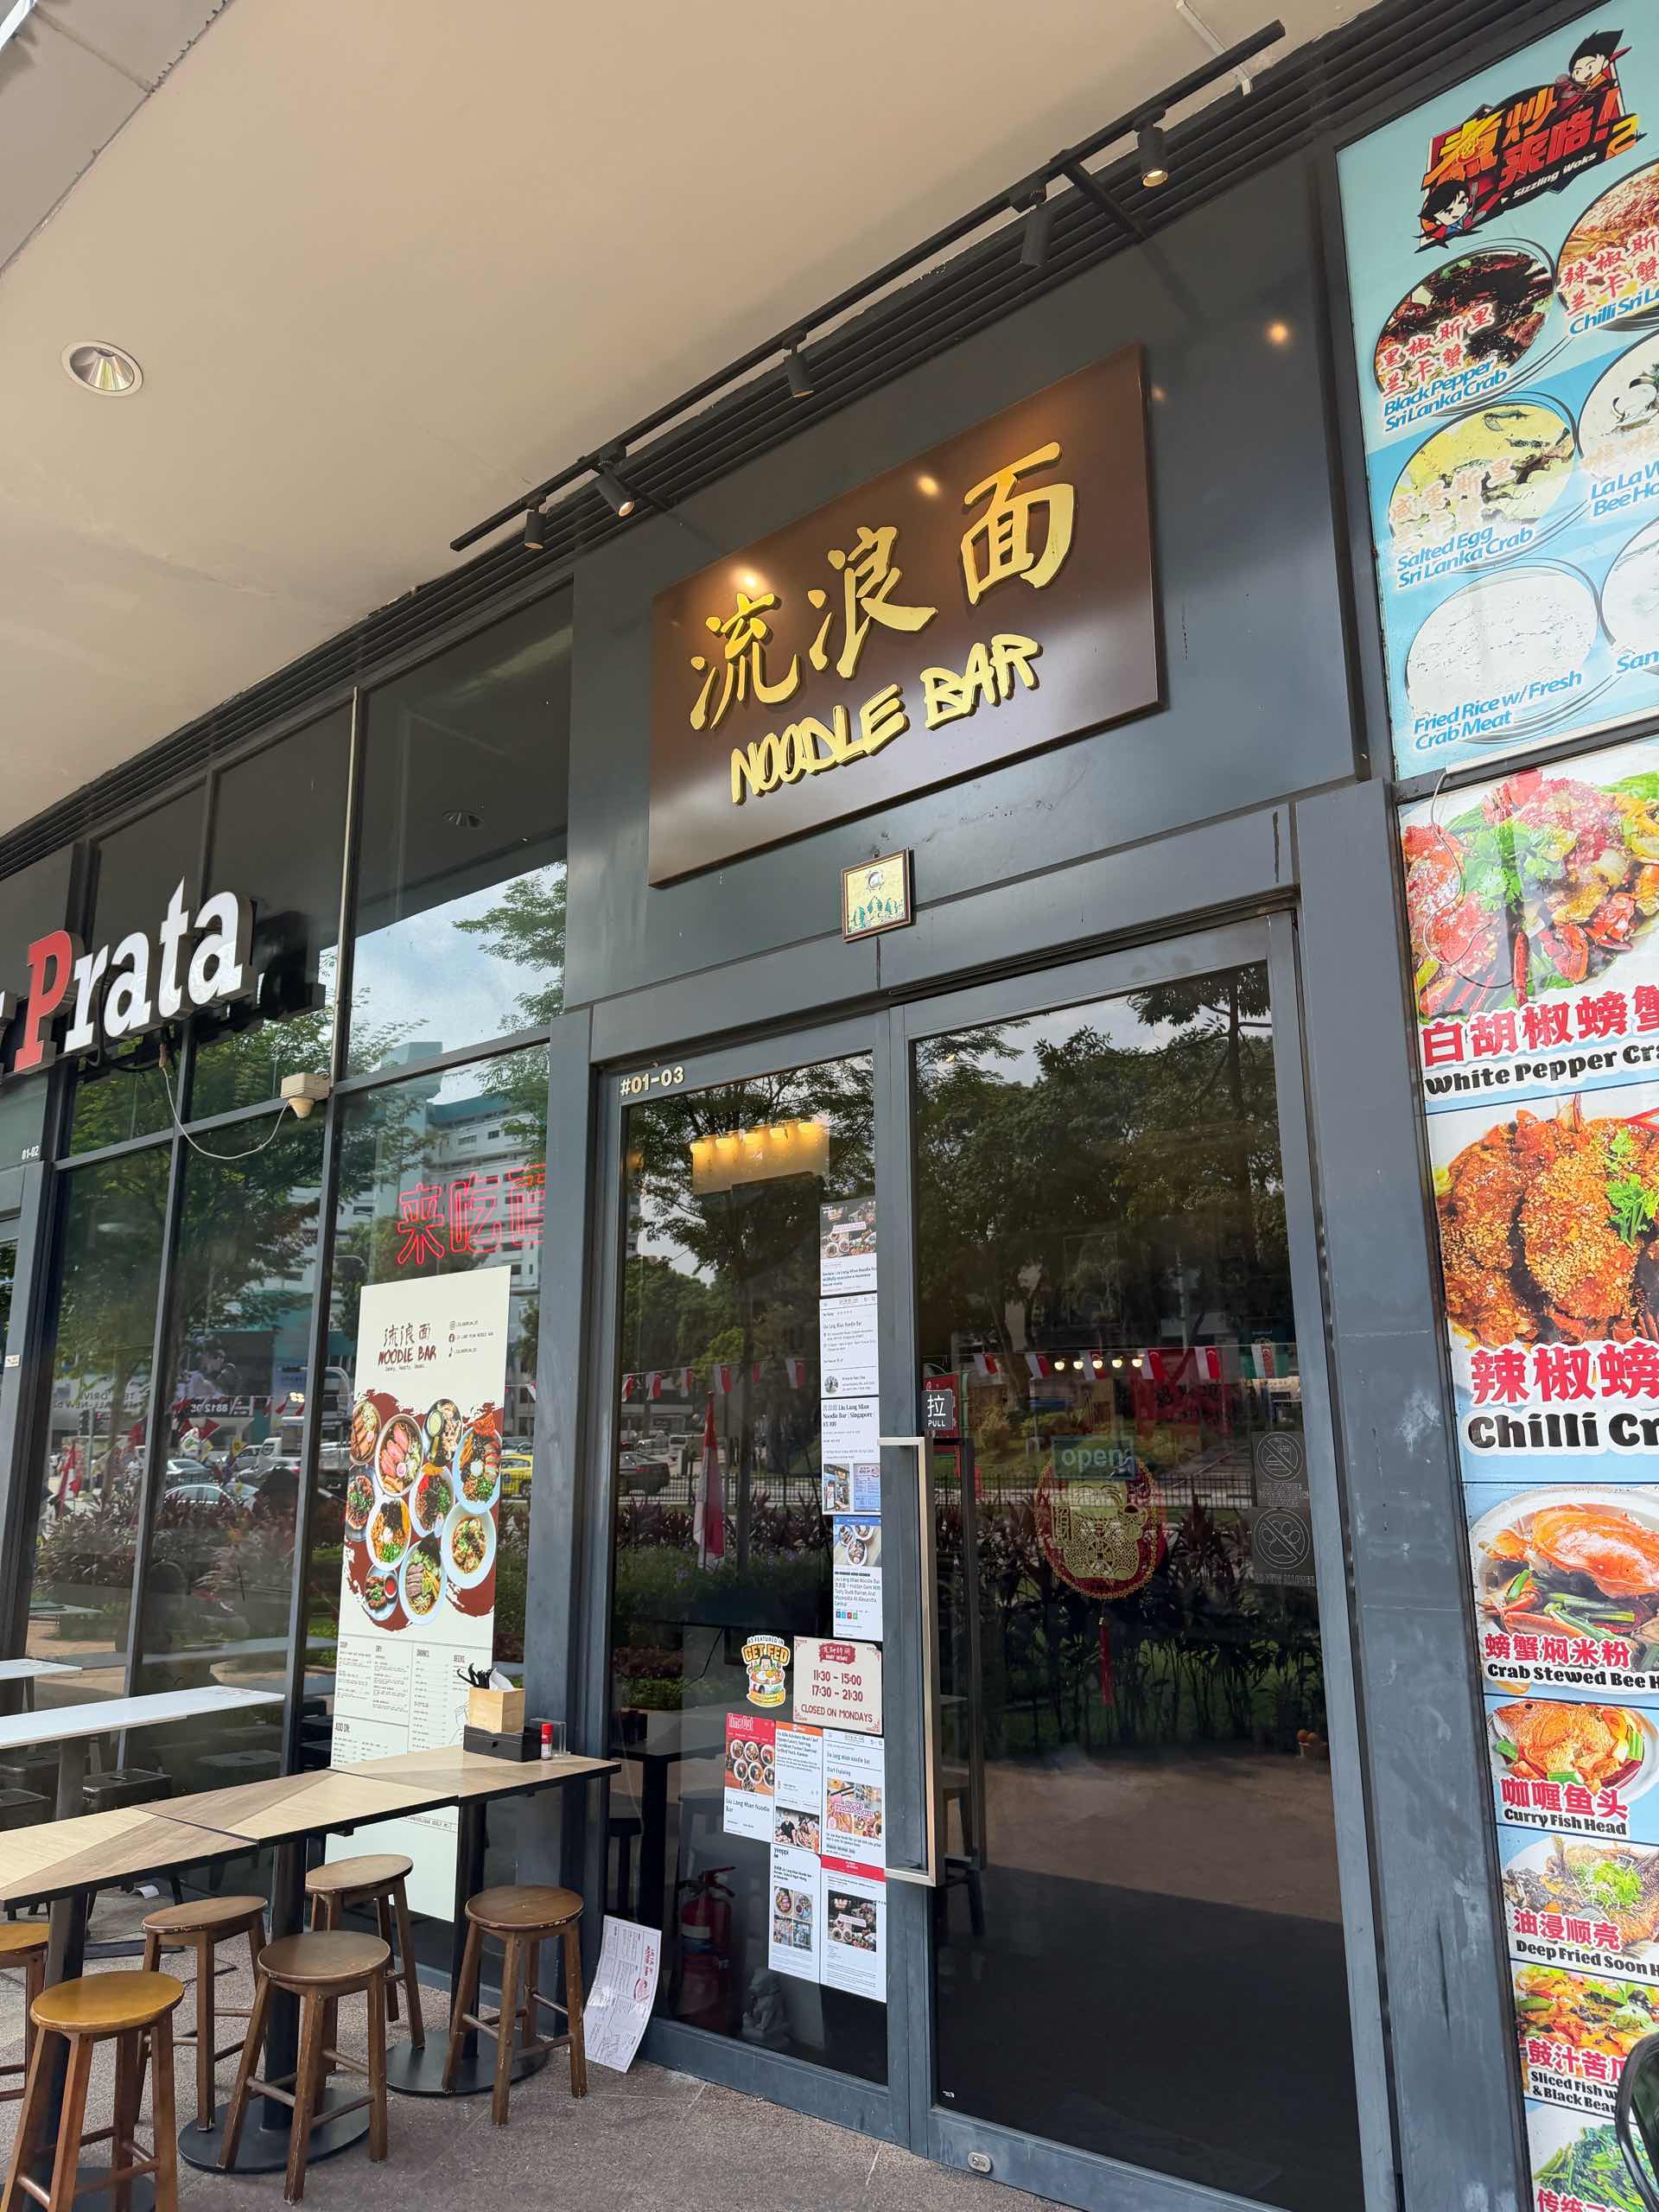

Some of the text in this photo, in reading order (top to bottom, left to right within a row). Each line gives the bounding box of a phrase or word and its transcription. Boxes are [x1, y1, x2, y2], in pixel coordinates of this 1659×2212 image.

[1513, 151, 1598, 200] Sizzling Woks
[1569, 302, 1617, 334] Chilli
[1617, 291, 1643, 315] Sri
[1383, 359, 1494, 416] Black Pepper
[1384, 370, 1508, 431] Sri Lanka Crab
[1592, 480, 1618, 499] La
[1618, 470, 1643, 490] La
[1592, 494, 1631, 517] Bee
[1397, 525, 1493, 571] Salted Egg
[1398, 528, 1534, 588] Sri Lanka Crab
[689, 441, 1077, 733] 流浪面
[1414, 709, 1460, 735] Fried
[1461, 696, 1502, 720] Rice
[1528, 670, 1583, 699] Fresh
[730, 632, 1043, 806] NOODLE BAR
[1414, 711, 1512, 751] Crab Meat
[14, 875, 247, 1073] Prata
[620, 1065, 684, 1096] #01-03
[1425, 1066, 1510, 1095] White
[1515, 1050, 1618, 1082] Pepper
[378, 1346, 414, 1367] NOODLE
[417, 1344, 437, 1362] BAR
[926, 1394, 947, 1418] 拉
[927, 1419, 947, 1427] PULL
[1467, 1411, 1599, 1449] Chilli
[1061, 1448, 1123, 1473] open
[744, 1643, 789, 1664] GET FED
[813, 1669, 831, 1682] 11:30
[841, 1672, 862, 1687] 15:00
[1487, 1663, 1530, 1681] Crab
[1534, 1668, 1607, 1686] Stewed
[1610, 1673, 1646, 1689] Bee
[811, 1684, 832, 1698] 17:30
[842, 1688, 864, 1702] 21:30
[800, 1703, 874, 1723] CLOSED ON MONDAYS
[1503, 1808, 1627, 1835] Curry Fish Head
[1516, 1939, 1557, 1961] Deep
[1558, 1947, 1601, 1967] Fried
[1603, 1955, 1649, 1976] Soon
[1531, 2070, 1573, 2091] Sliced
[1574, 2082, 1603, 2097] Fish
[1533, 2085, 1542, 2096] &
[1544, 2087, 1583, 2106] Black
